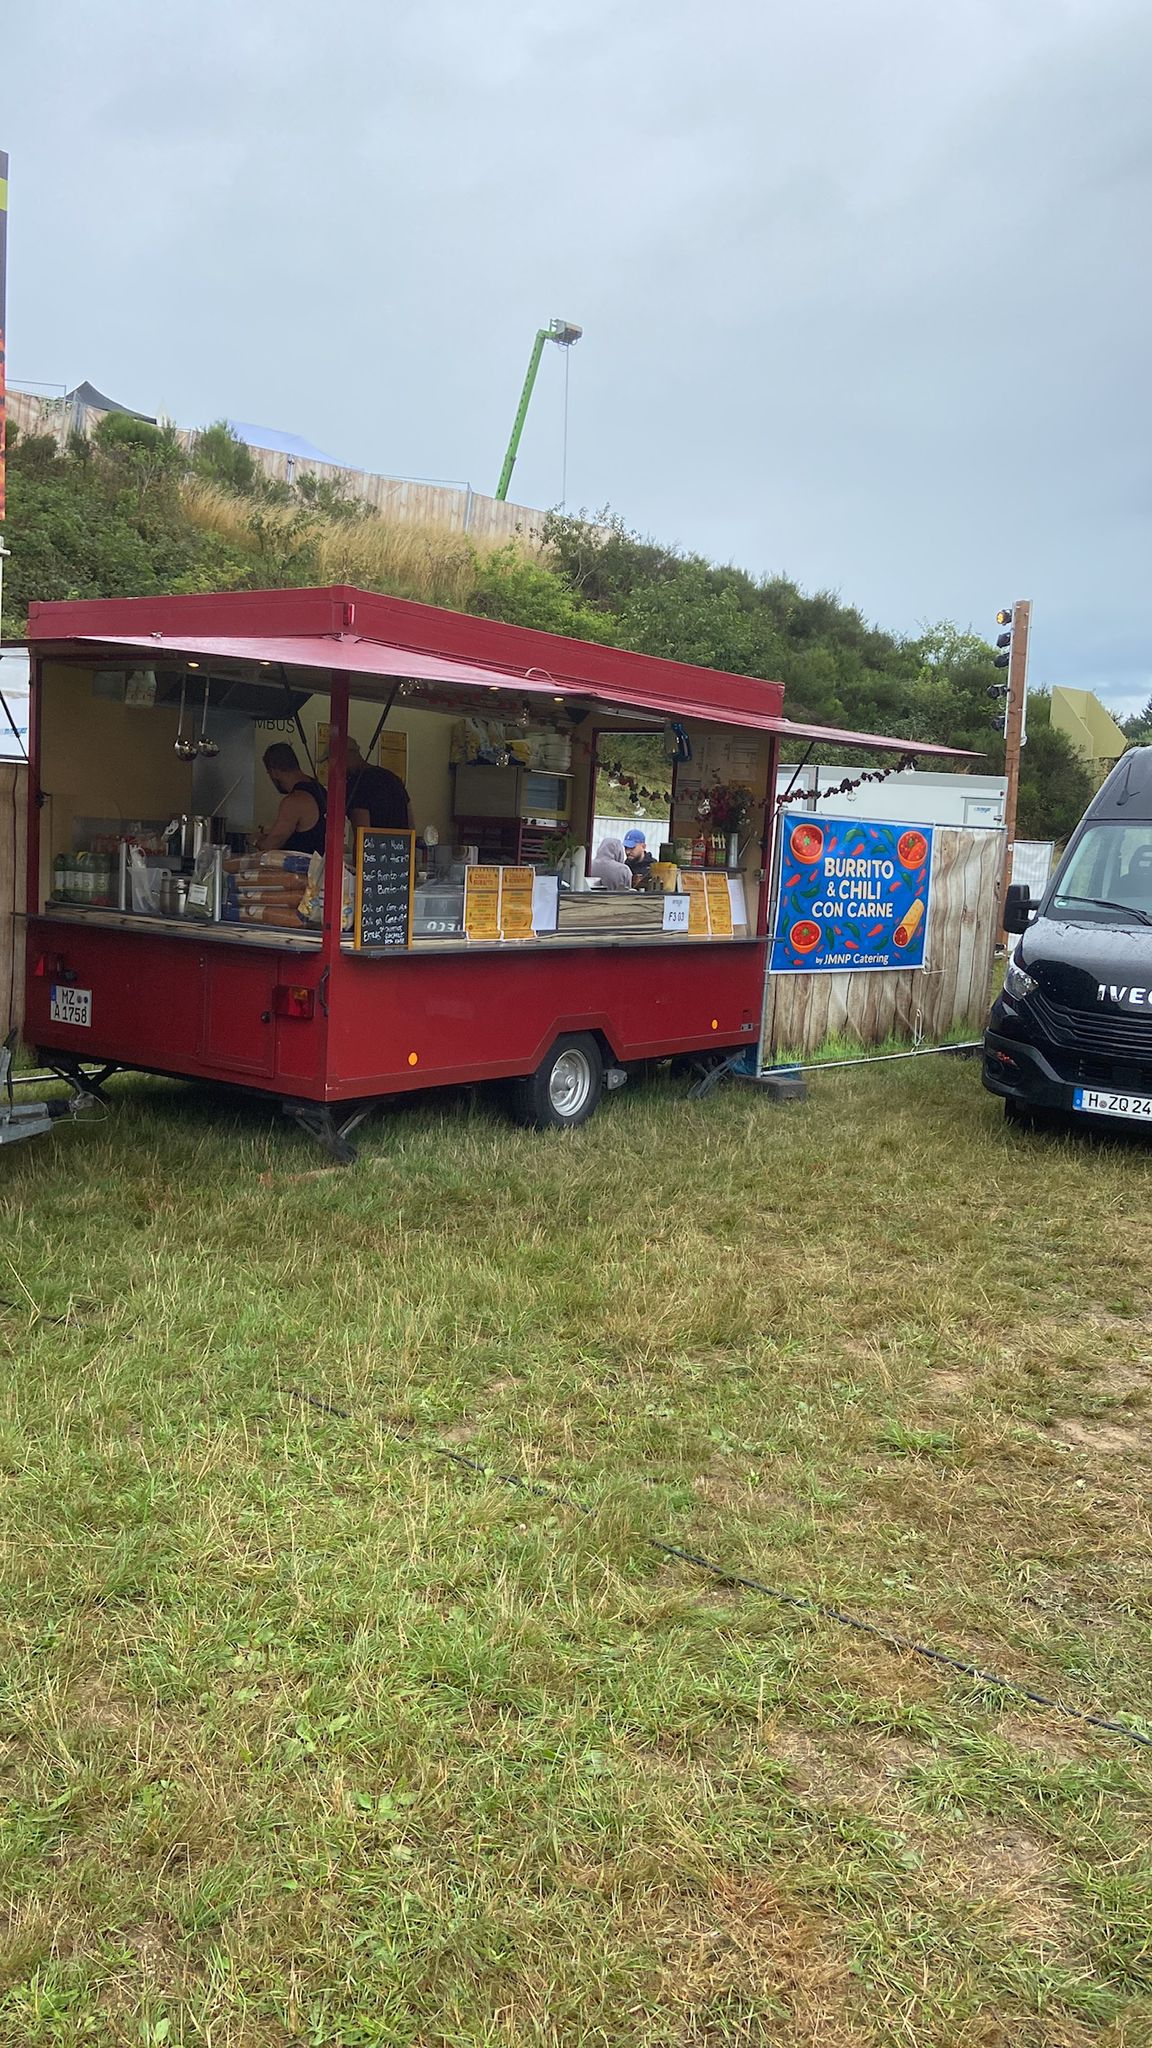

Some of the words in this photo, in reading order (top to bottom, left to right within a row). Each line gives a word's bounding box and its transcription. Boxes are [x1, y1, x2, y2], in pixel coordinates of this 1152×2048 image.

[824, 857, 894, 879] BURRITO
[826, 881, 836, 897] &
[838, 880, 881, 899] CHILI
[812, 901, 844, 918] CON
[847, 902, 893, 918] CARNE
[815, 957, 823, 965] by
[824, 954, 852, 965] JMNP
[853, 952, 889, 965] Catering
[62, 989, 75, 1005] MZ
[1096, 984, 1152, 1005] IVE
[54, 1004, 61, 1019] A
[62, 1006, 87, 1024] 1758
[1088, 1094, 1099, 1108] H
[1108, 1096, 1129, 1112] ZQ
[1132, 1100, 1151, 1115] 24
